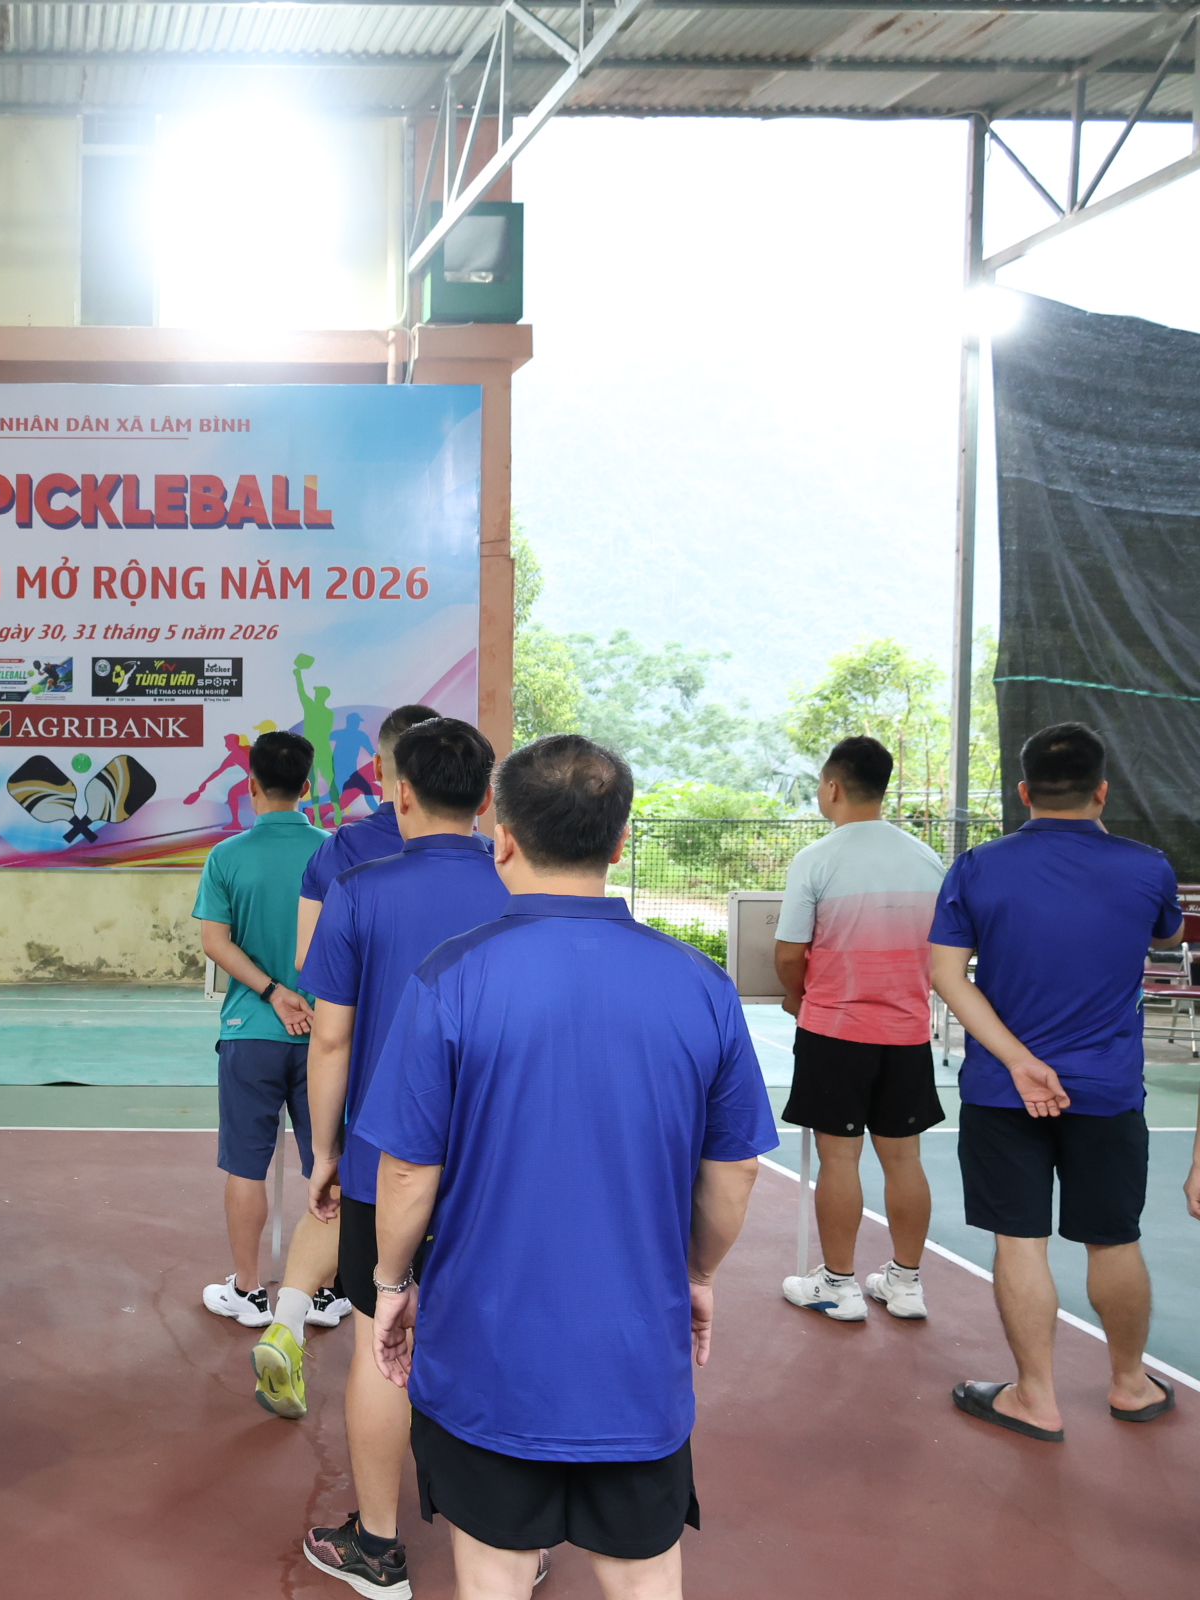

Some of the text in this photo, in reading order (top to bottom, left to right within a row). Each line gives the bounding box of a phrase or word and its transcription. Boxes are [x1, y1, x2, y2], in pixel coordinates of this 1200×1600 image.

[0, 415, 59, 431] NHÂN
[66, 415, 109, 432] DÂN
[116, 415, 144, 432] XÃ
[150, 415, 192, 432] LÂM
[199, 415, 251, 432] BÌNH
[16, 557, 80, 599] MỞ
[93, 559, 206, 607] RỘNG
[221, 559, 311, 600] NĂM
[325, 566, 429, 600] 2026
[38, 624, 68, 642] 30,
[72, 624, 97, 640] 31
[102, 623, 161, 643] tháng
[164, 624, 179, 640] 5
[181, 624, 226, 640] năm
[229, 624, 280, 640] 2026
[205, 665, 231, 673] zocker
[135, 670, 196, 686] TÙNG VÂN
[197, 677, 238, 687] SPORT
[16, 716, 189, 739] AGRIBANK
